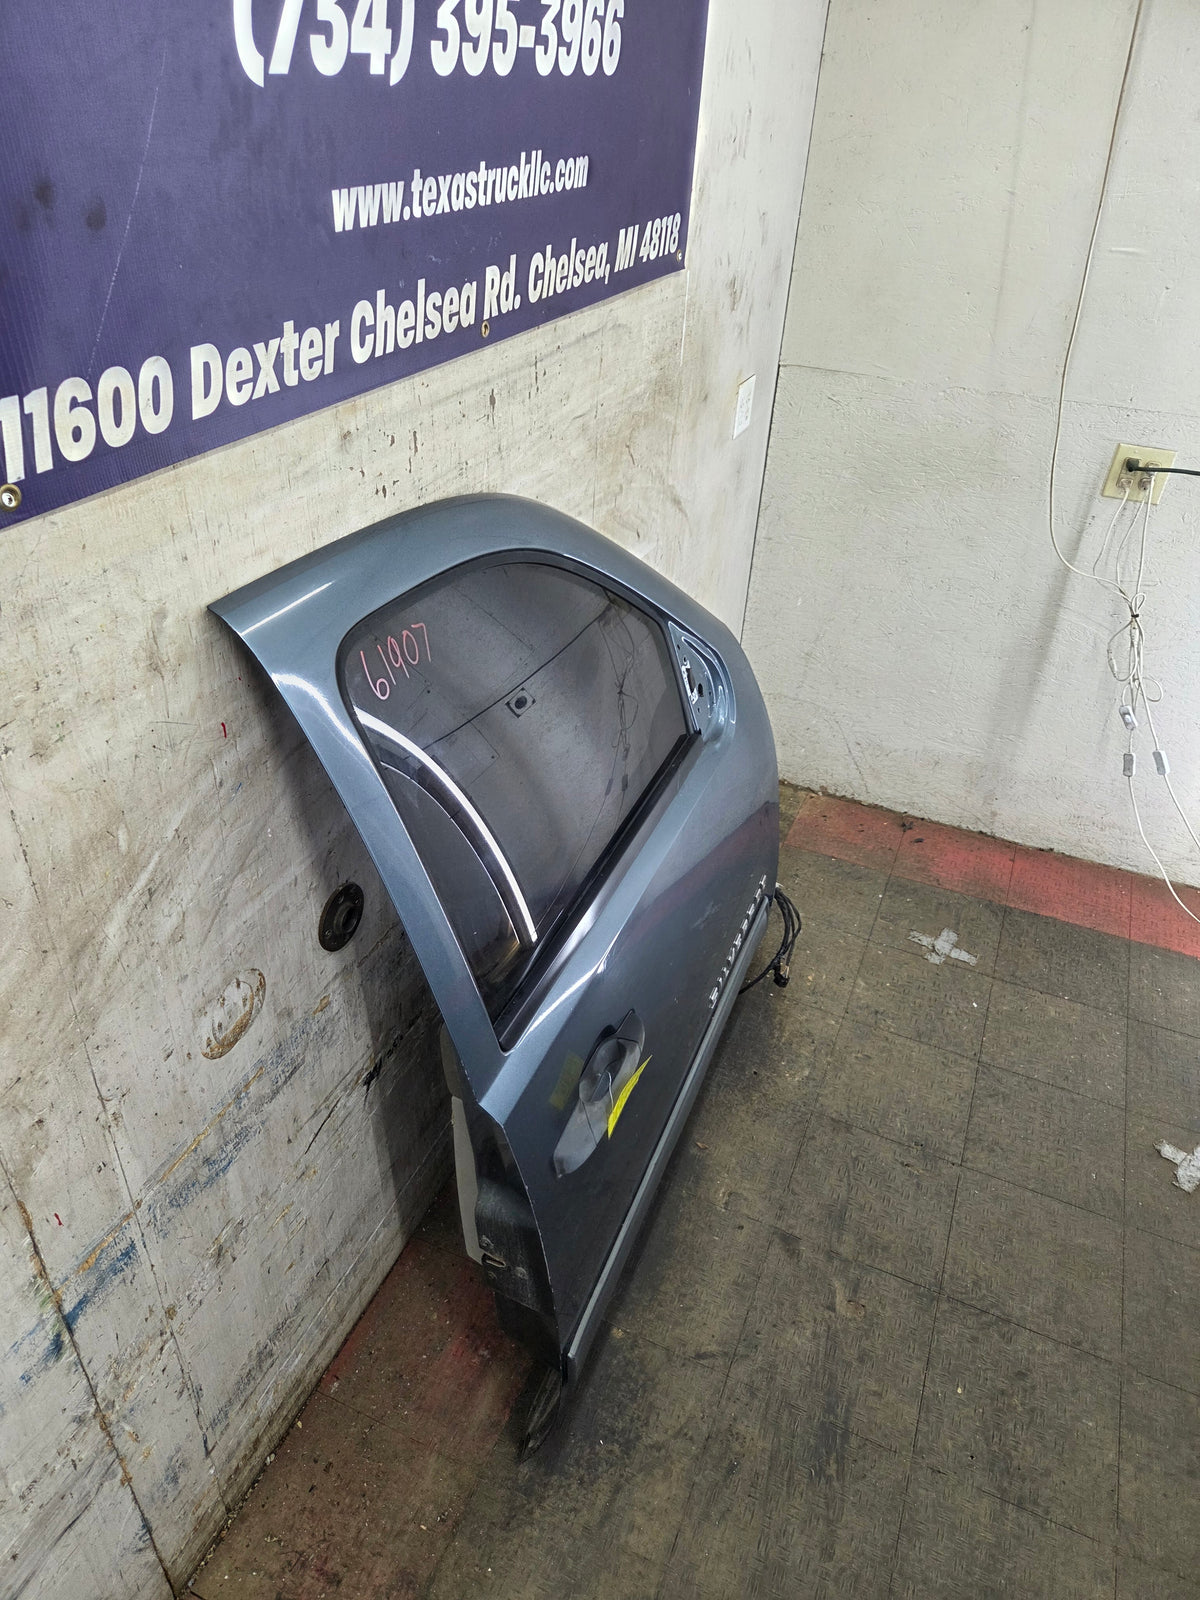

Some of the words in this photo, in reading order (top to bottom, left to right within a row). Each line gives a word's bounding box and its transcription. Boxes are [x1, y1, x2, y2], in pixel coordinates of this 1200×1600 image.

[430, 0, 625, 77] 395-3966
[331, 150, 589, 232] www.texastruckllc.com
[0, 355, 174, 484] 11600
[190, 320, 340, 420] Dexter
[350, 278, 477, 364] Chelsea
[483, 254, 521, 321] Rd.
[528, 237, 610, 303] Chelsea,
[614, 224, 640, 273] MI
[638, 212, 682, 263] 48118
[360, 622, 431, 700] 61907
